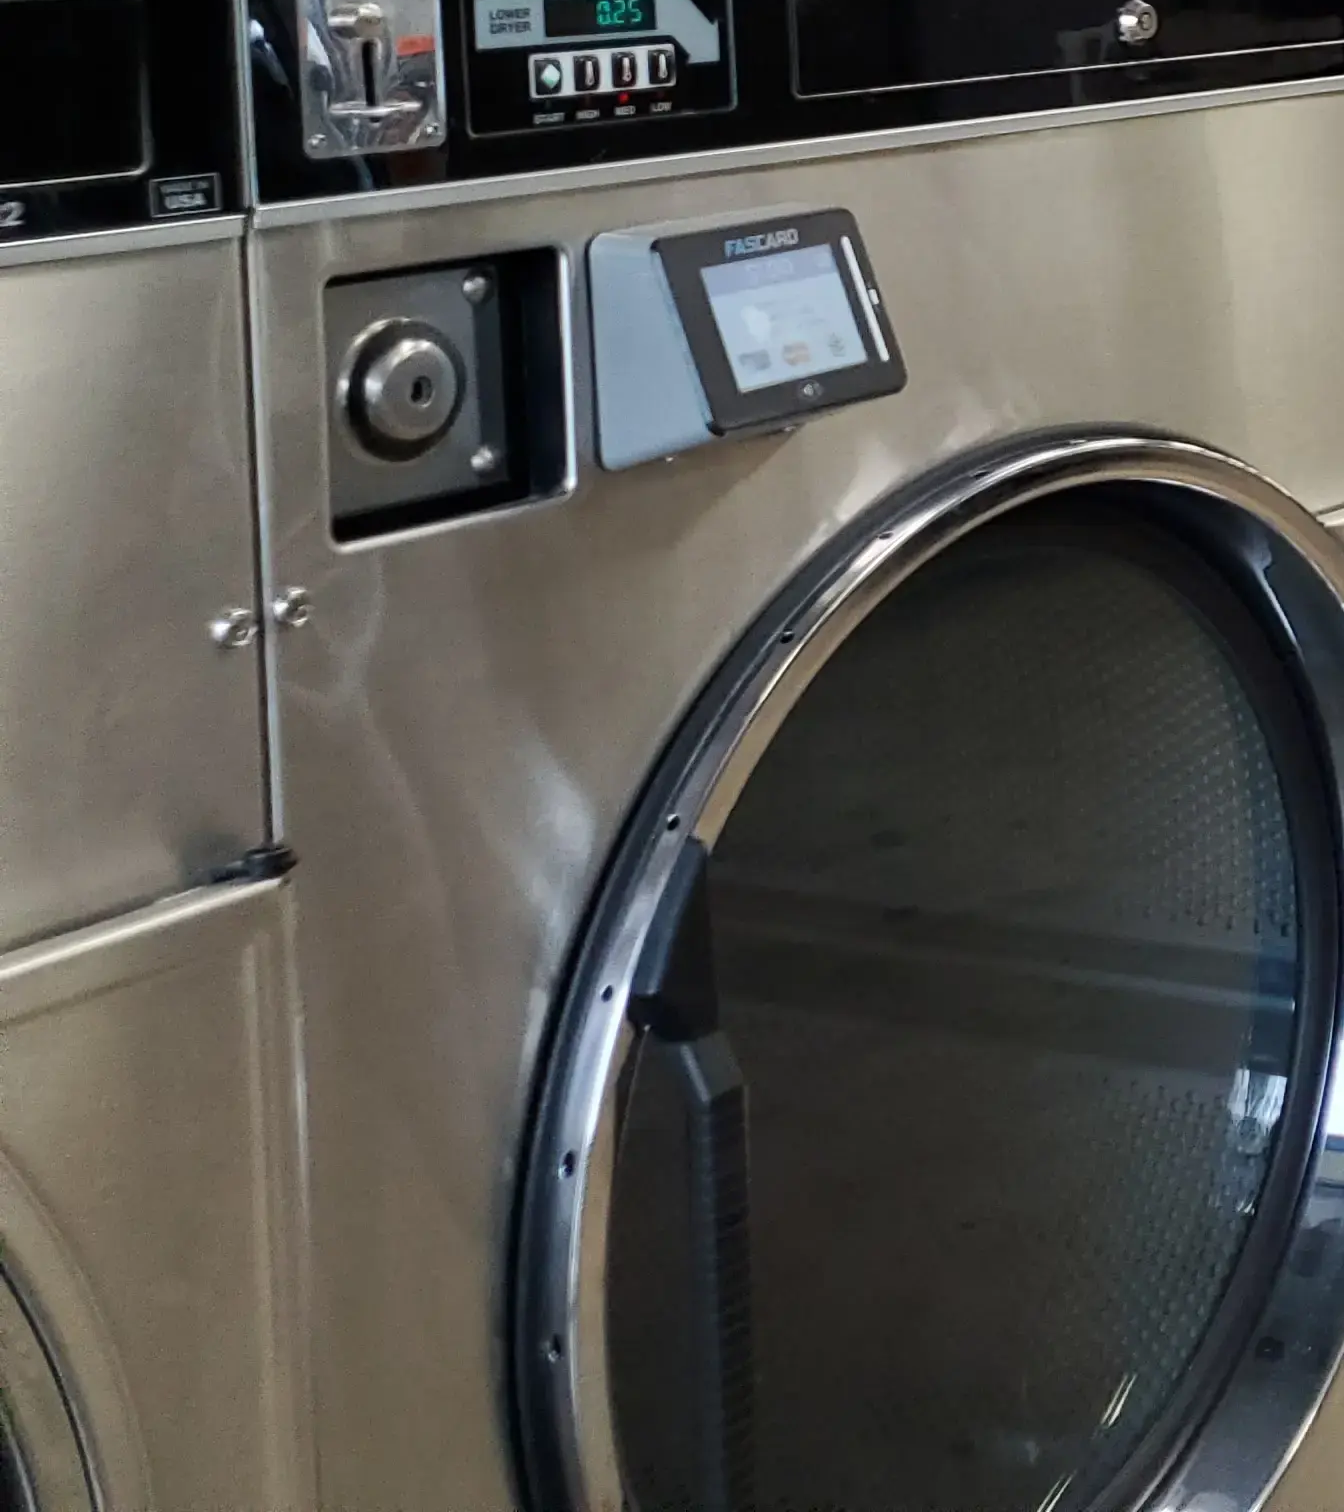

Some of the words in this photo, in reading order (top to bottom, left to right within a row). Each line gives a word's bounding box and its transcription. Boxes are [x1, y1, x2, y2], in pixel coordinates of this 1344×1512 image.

[489, 8, 532, 21] LOWER
[489, 21, 532, 35] DRYER
[723, 228, 800, 258] FASCARD
